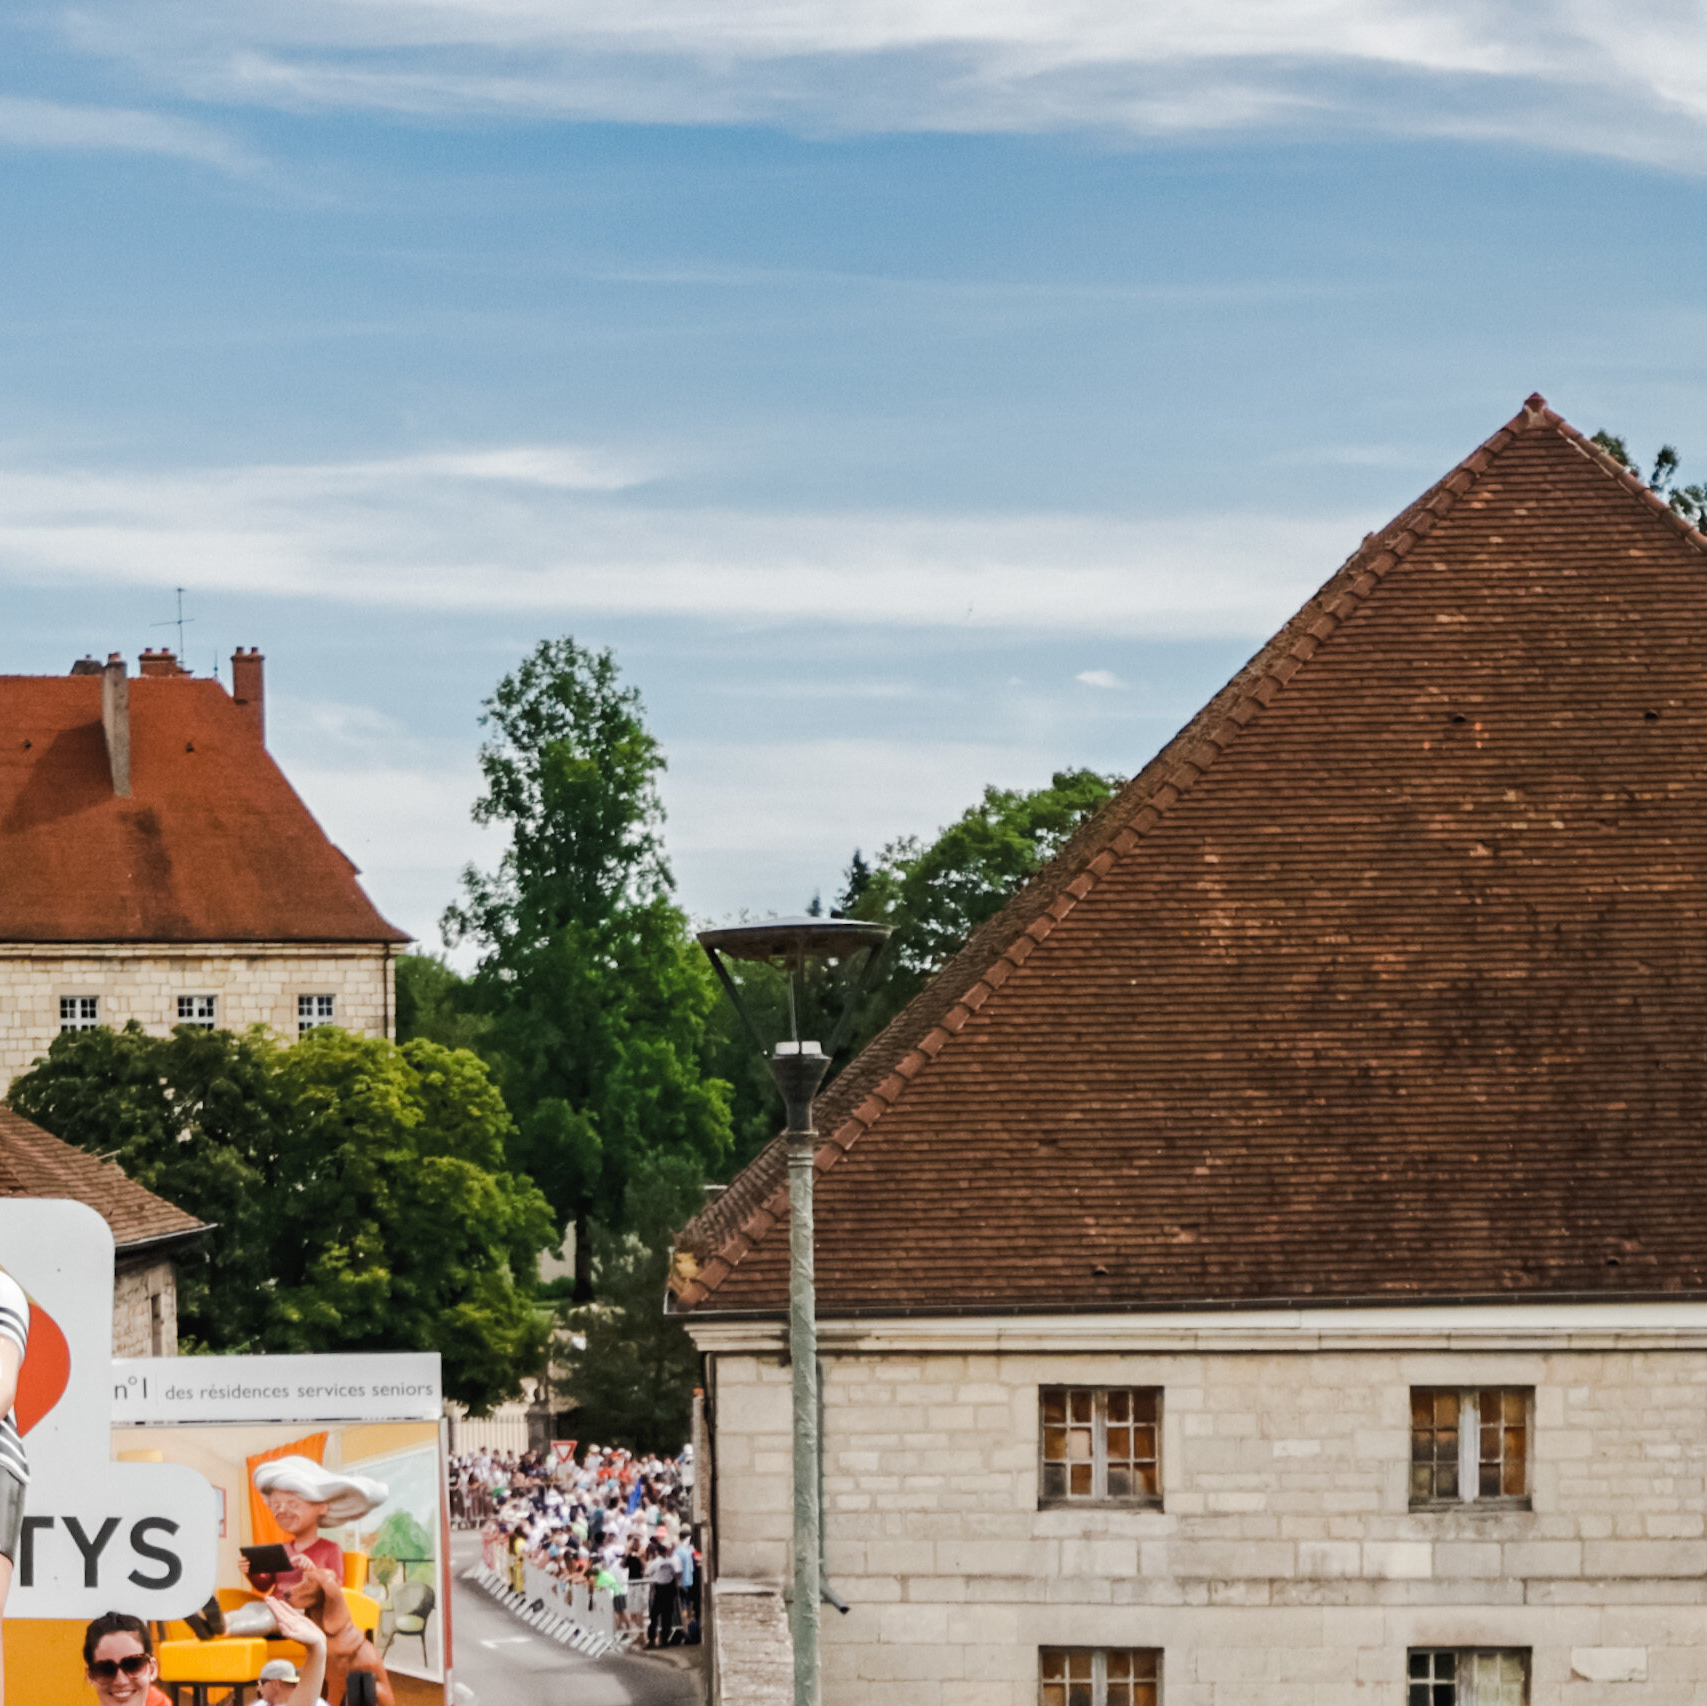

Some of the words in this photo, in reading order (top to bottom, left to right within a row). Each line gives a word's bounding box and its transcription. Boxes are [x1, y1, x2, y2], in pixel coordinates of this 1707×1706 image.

[165, 1385, 193, 1400] des
[200, 1382, 289, 1400] résidences
[297, 1383, 365, 1398] services
[372, 1381, 433, 1397] seniors
